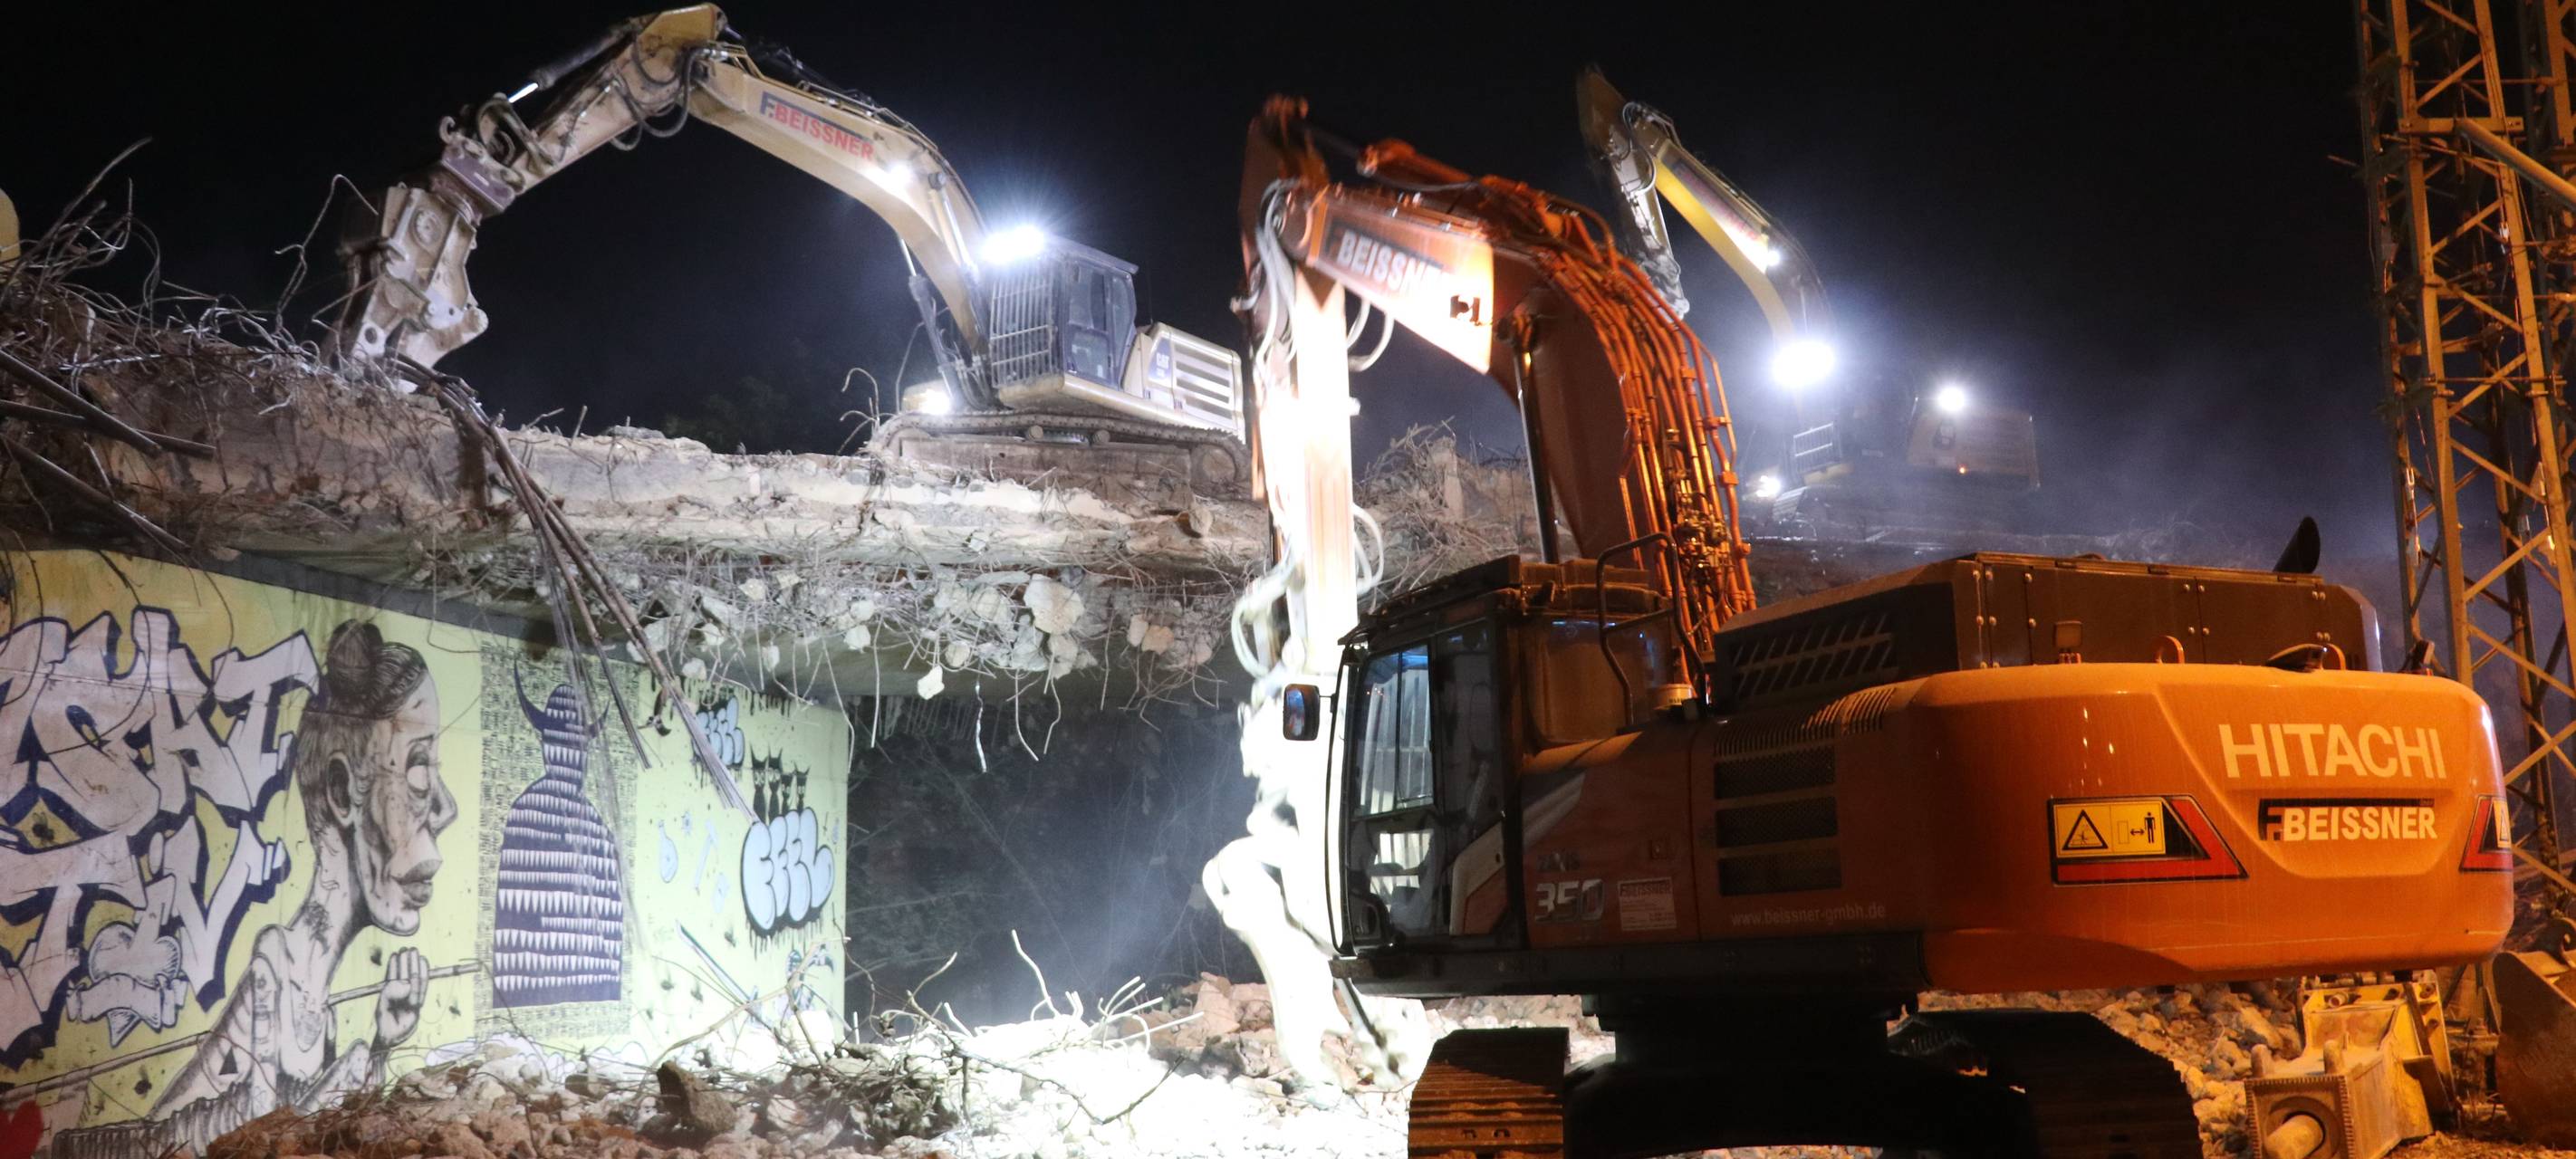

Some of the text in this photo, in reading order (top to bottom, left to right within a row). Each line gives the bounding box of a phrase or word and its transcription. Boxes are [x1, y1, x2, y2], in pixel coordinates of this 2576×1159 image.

[2219, 723, 2446, 780] HITACHI
[1534, 878, 1605, 923] 350
[1730, 902, 1886, 926] www.beissner-gmbh.de
